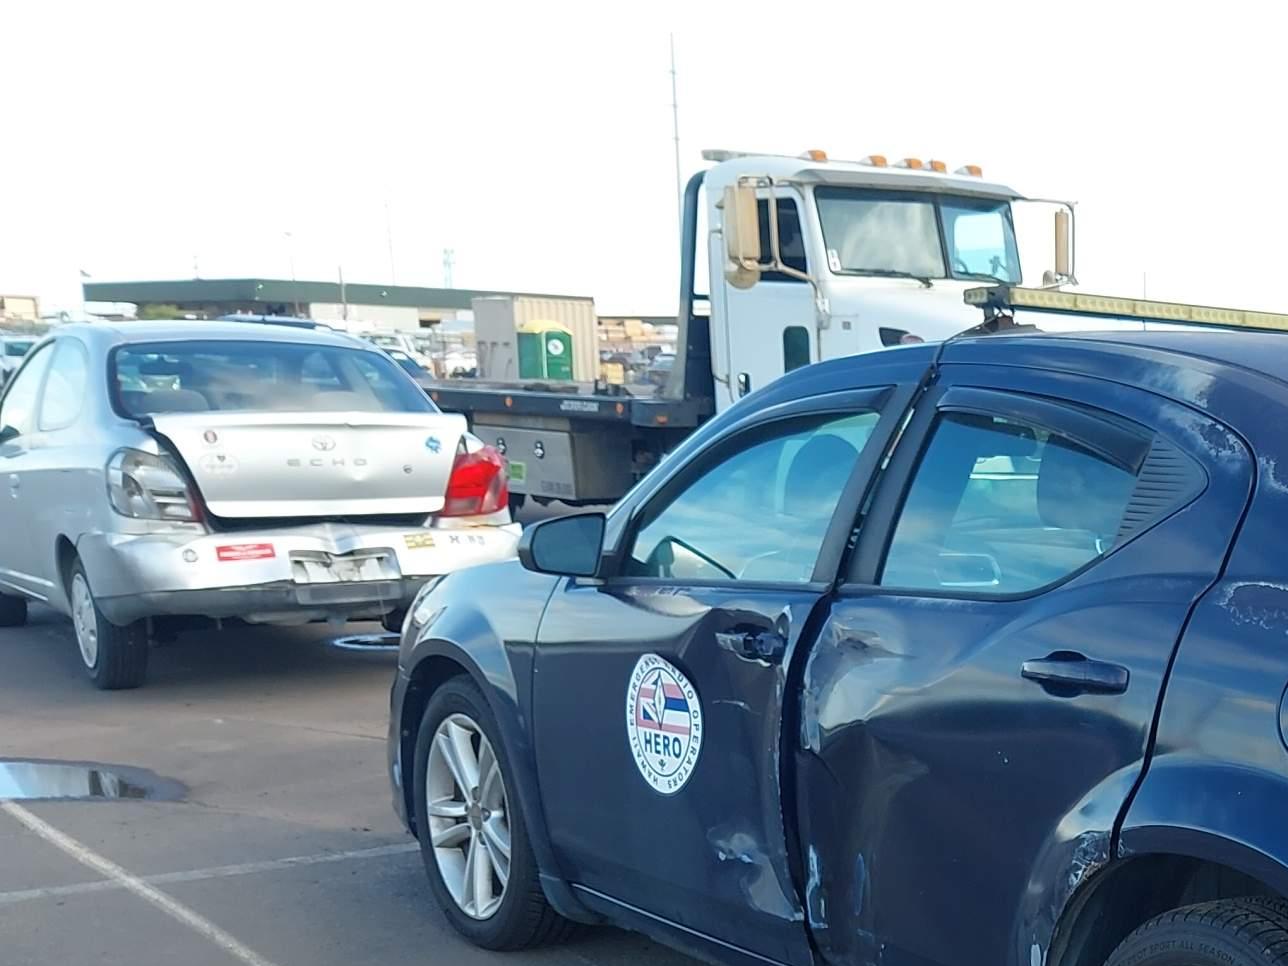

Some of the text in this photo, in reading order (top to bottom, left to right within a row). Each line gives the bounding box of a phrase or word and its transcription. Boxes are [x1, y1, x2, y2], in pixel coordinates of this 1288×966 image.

[286, 457, 368, 467] ECHO
[643, 730, 683, 760] HERO
[667, 709, 700, 790] OPERATORS
[1180, 939, 1194, 951] ALL
[1199, 942, 1236, 966] SEASON
